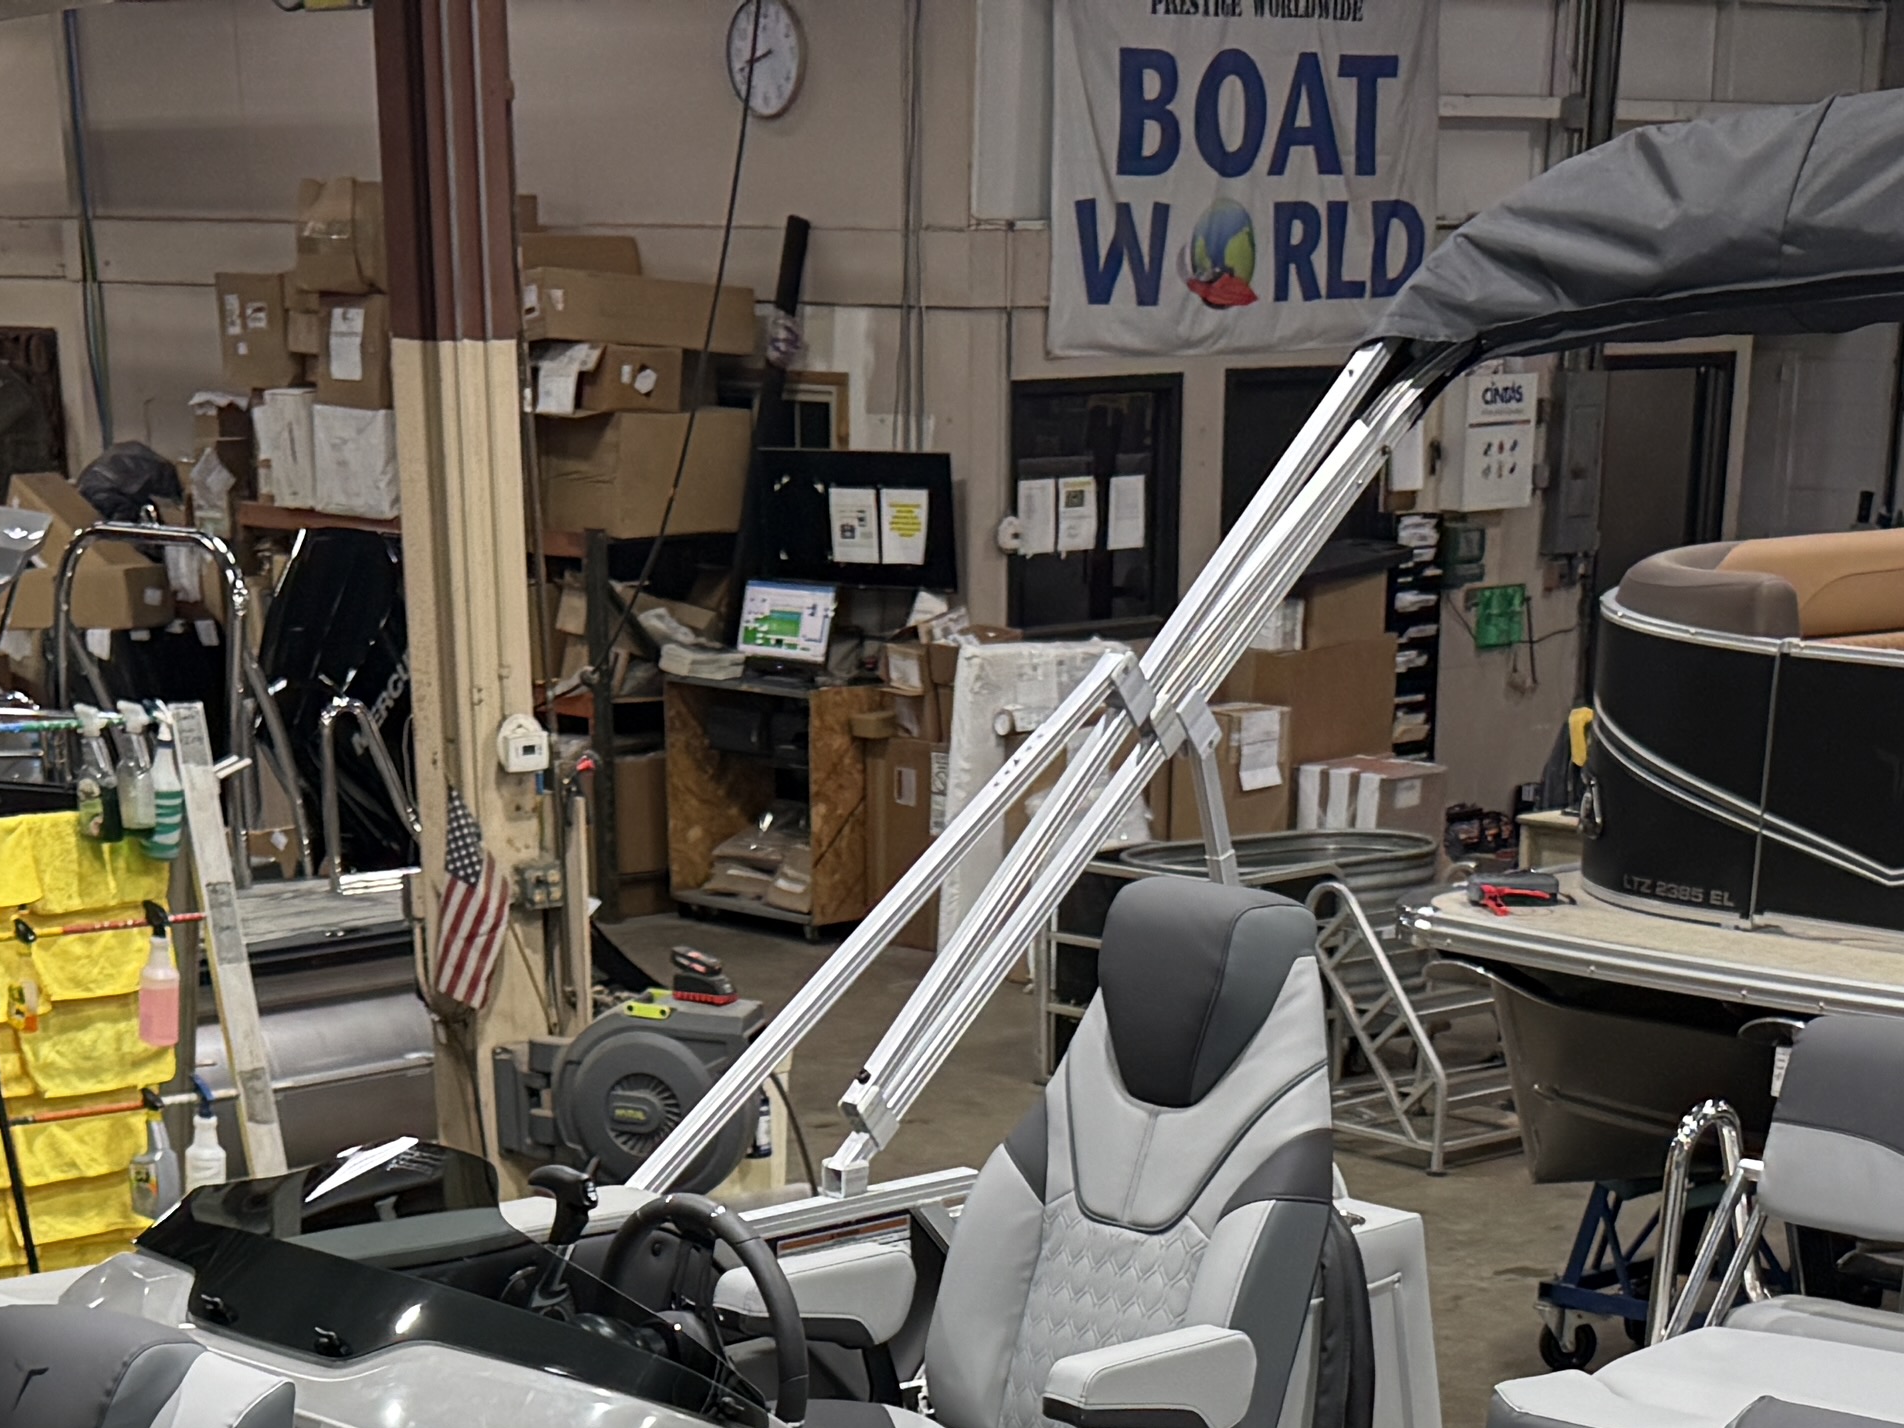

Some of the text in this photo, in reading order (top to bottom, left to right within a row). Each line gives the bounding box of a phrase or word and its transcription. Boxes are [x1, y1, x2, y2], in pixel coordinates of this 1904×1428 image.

[1116, 46, 1399, 178] BOAT
[1622, 873, 1736, 908] LTZ 2385 EL
